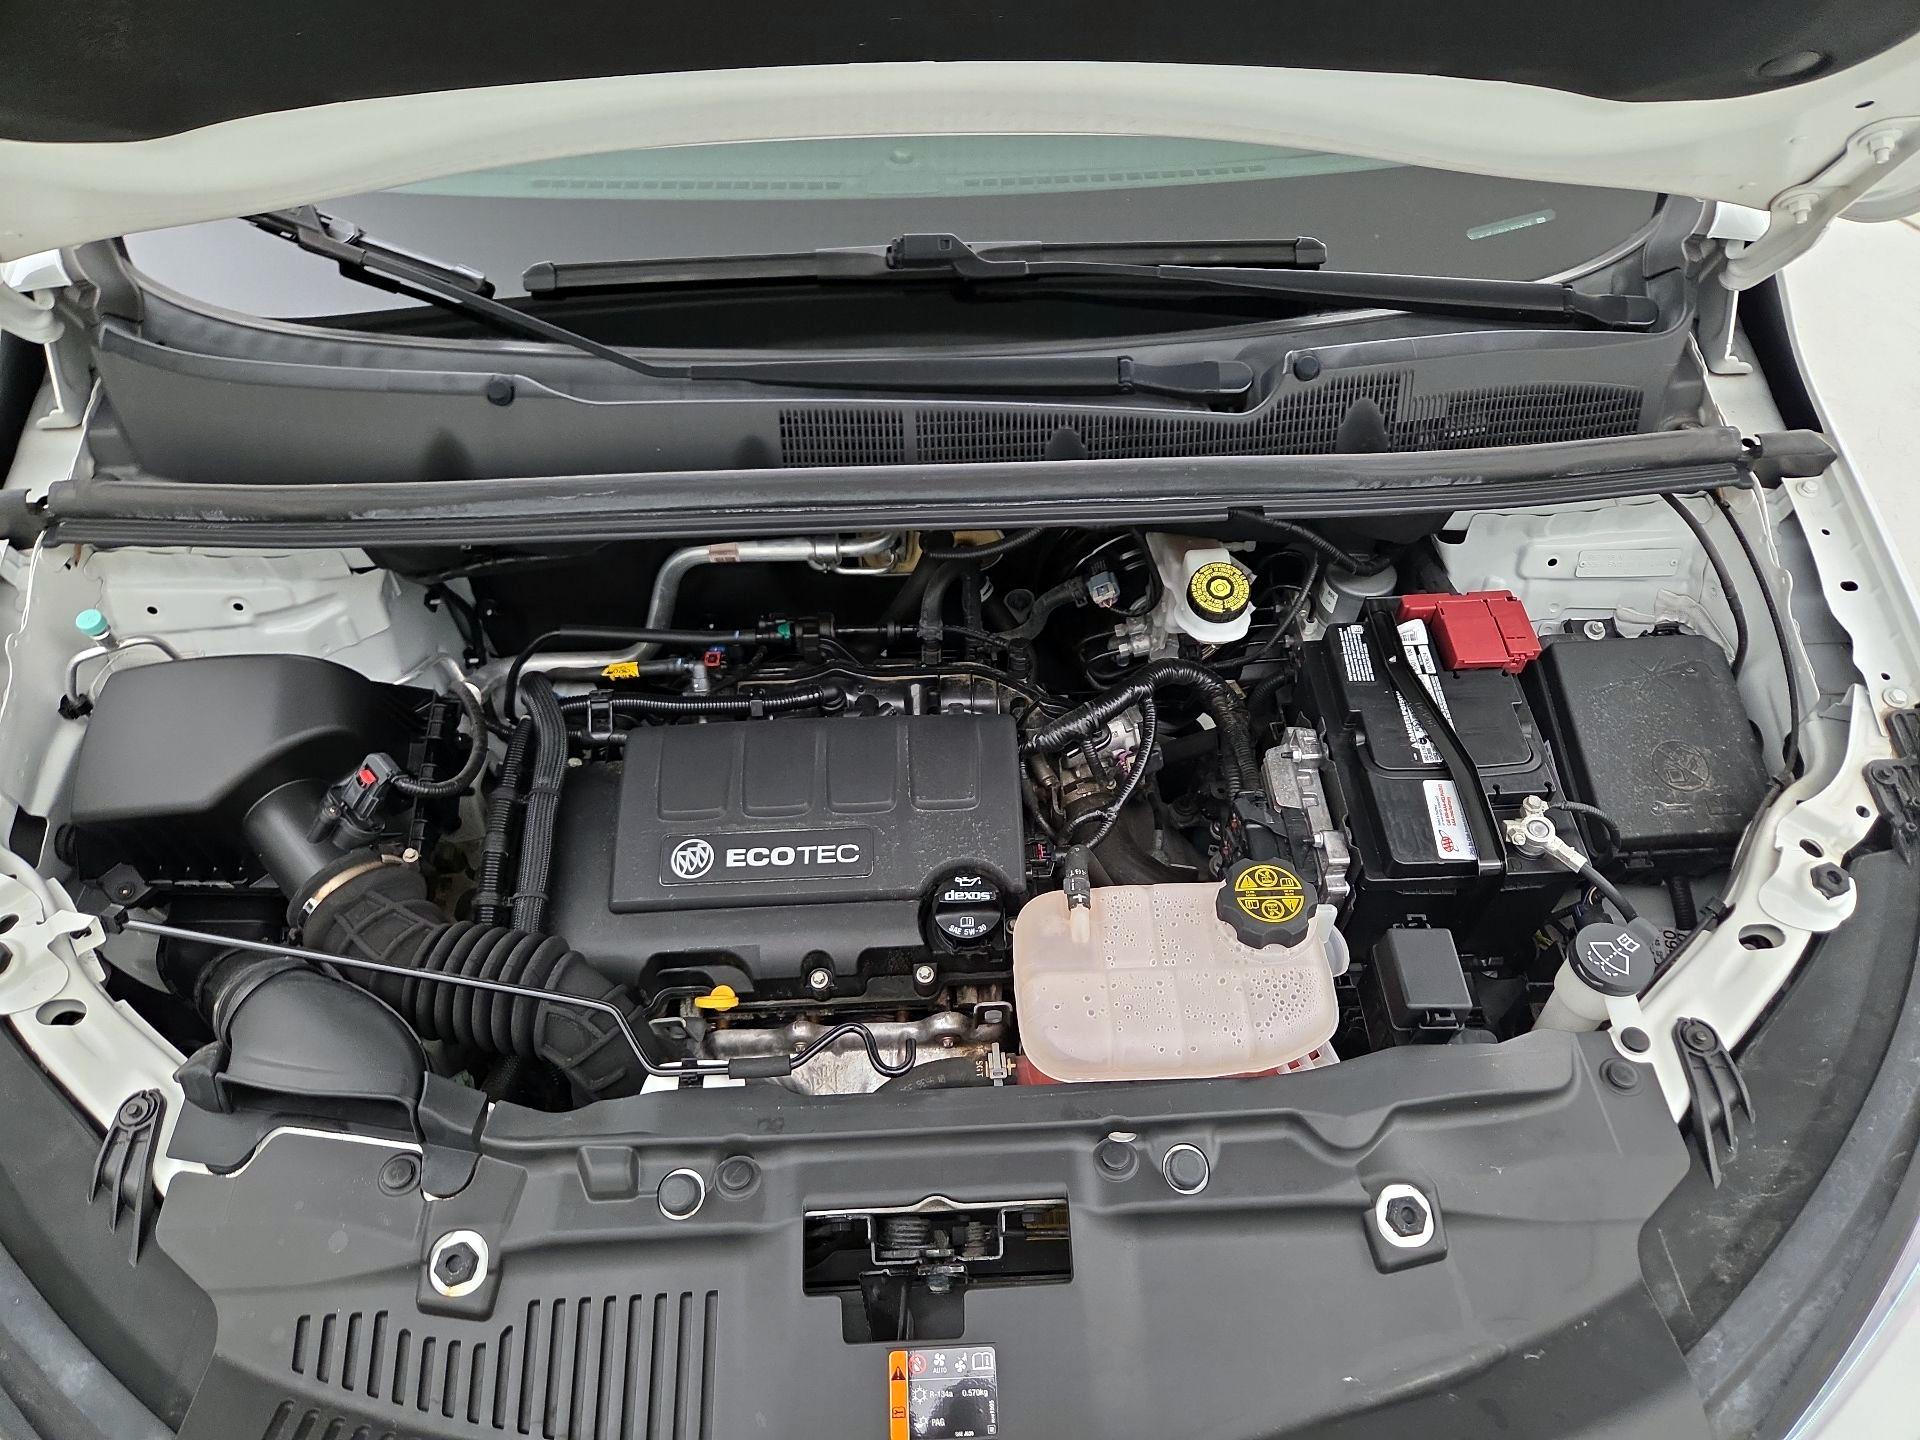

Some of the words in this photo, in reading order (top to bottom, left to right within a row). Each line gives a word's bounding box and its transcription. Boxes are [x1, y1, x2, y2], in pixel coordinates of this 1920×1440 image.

[726, 843, 860, 867] ECOTEC
[944, 890, 991, 901] dexos
[948, 924, 962, 935] SAE
[964, 923, 987, 935] 5W-30
[929, 1389, 954, 1398] R-134a
[931, 1417, 946, 1427] PAG
